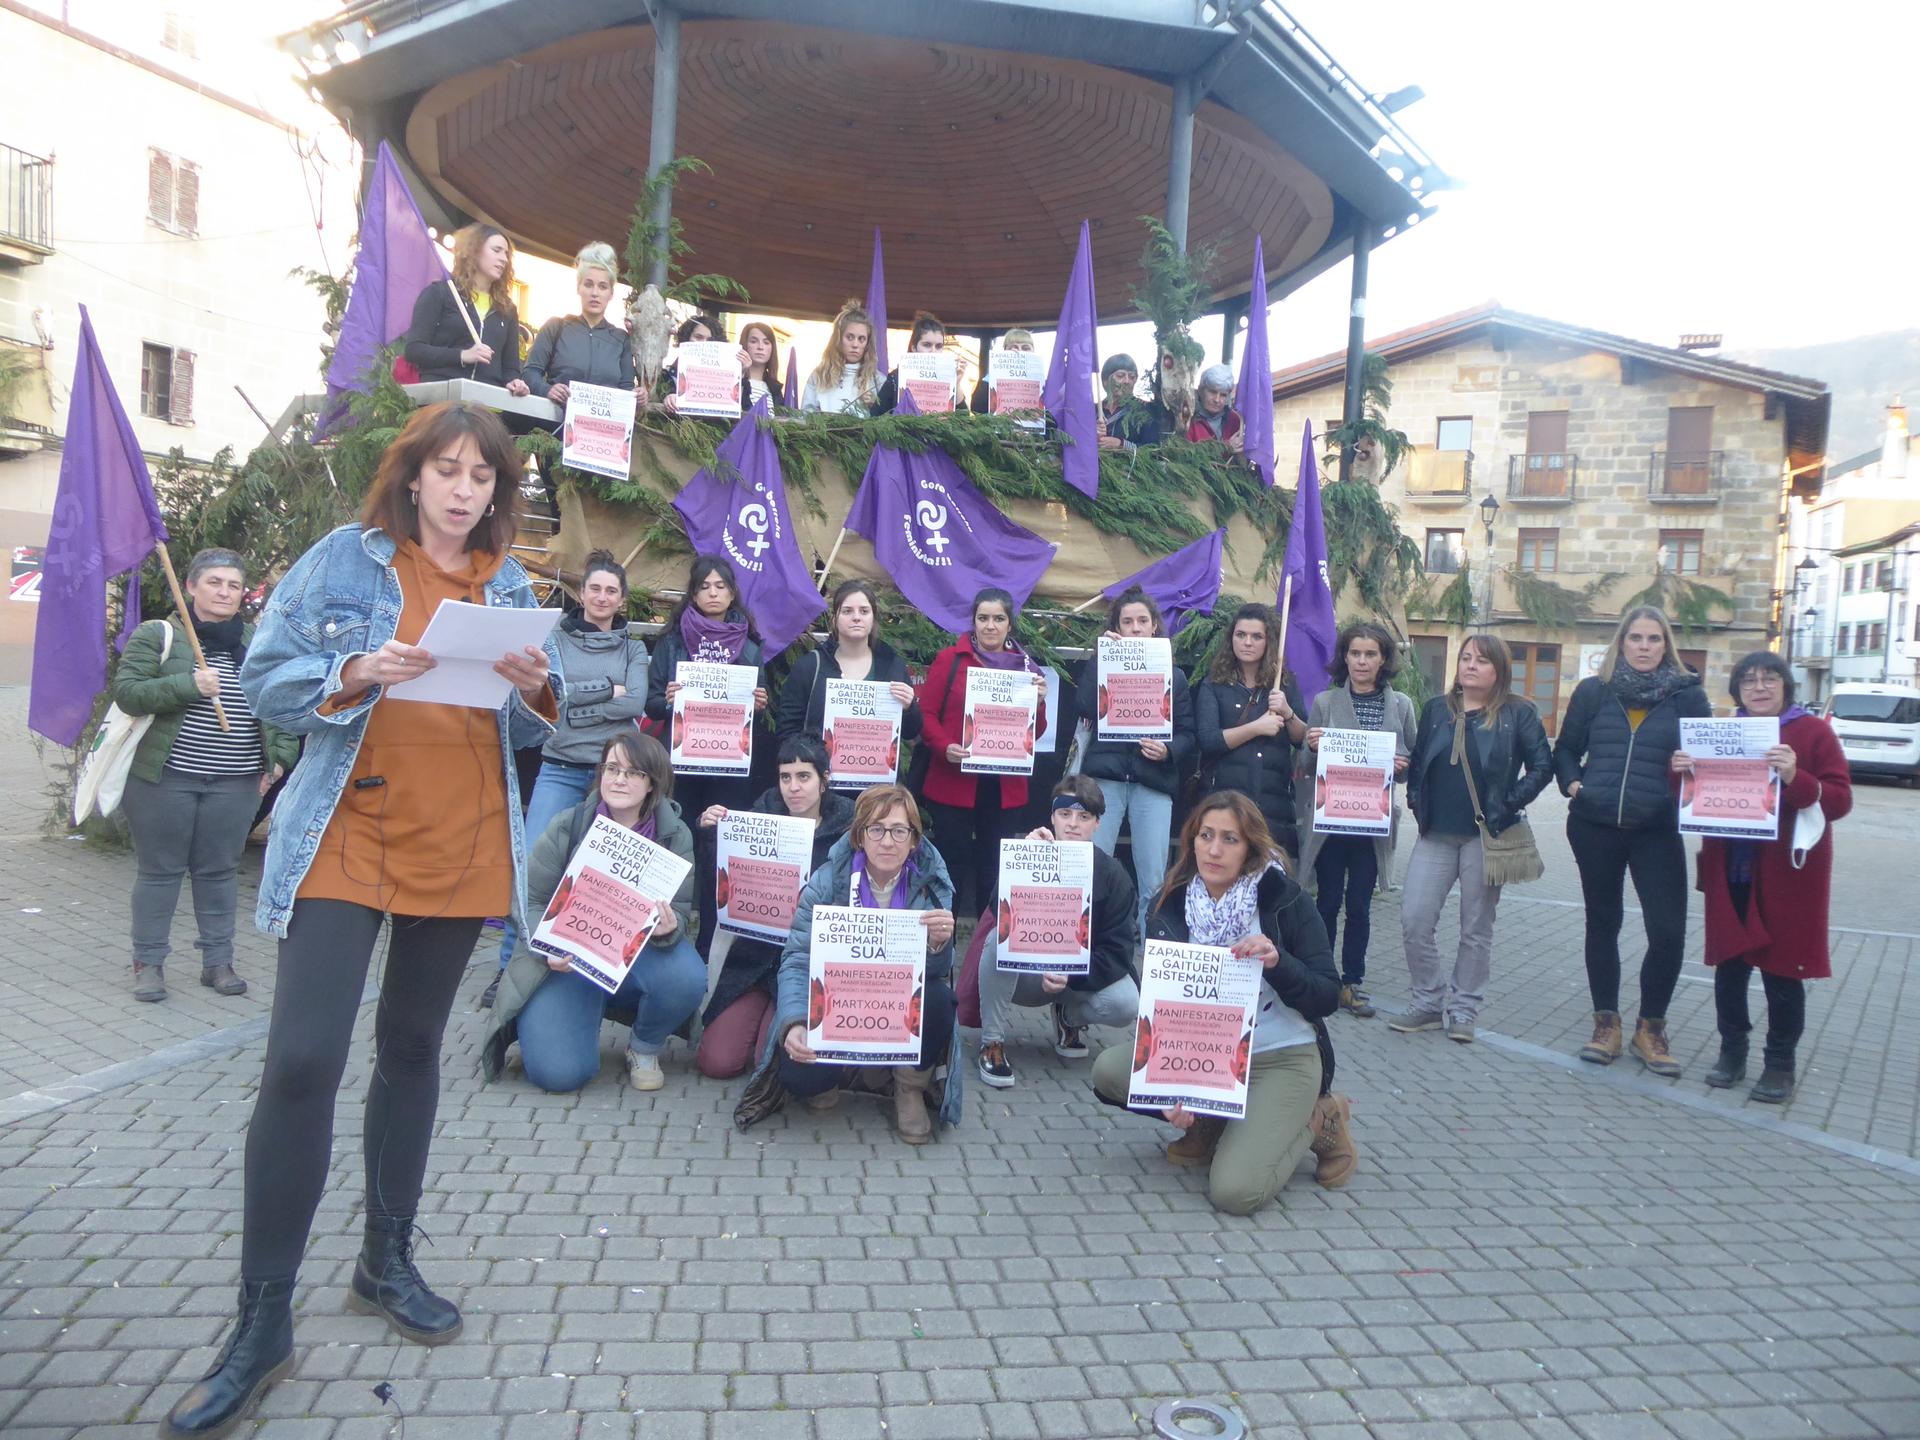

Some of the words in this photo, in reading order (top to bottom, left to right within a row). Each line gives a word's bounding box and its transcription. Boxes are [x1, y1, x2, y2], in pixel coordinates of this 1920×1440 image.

[701, 358, 720, 367] SUA
[692, 391, 722, 400] 20:00
[590, 407, 611, 417] SUA
[581, 444, 612, 455] 20:00
[921, 480, 945, 493] Gora
[679, 665, 728, 674] ZAPALTZEN
[1124, 662, 1147, 670] SUA
[689, 673, 727, 682] GAITUEN
[969, 671, 1012, 680] ZAPALTZEN
[681, 680, 727, 689] SISTEMARI
[829, 683, 875, 691] ZAPALTZEN
[978, 678, 1012, 687] GAITUEN
[971, 685, 1011, 693] SISTEMARI
[704, 690, 728, 700] SUA
[992, 694, 1012, 703] SUA
[831, 698, 874, 706] SISTEMARI
[685, 706, 744, 715] MANIFESTAZIOA
[852, 706, 875, 716] SUA
[975, 709, 1028, 718] MANIFESTAZIOA
[1116, 709, 1150, 718] 20:00
[689, 727, 733, 736] MARTXOAK
[834, 722, 892, 731] MANIFESTAZIOA
[1323, 732, 1367, 740] ZAPALTZEN
[691, 739, 729, 750] 20:00
[980, 739, 1014, 750] 20:00
[1323, 746, 1366, 754] SISTEMARI
[1715, 746, 1745, 756] SUA
[840, 755, 876, 766] 20:00
[1344, 755, 1368, 764] SUA
[1327, 770, 1384, 778] MANIFESTAZIOA
[1333, 800, 1369, 811] 20:00
[1704, 797, 1749, 809] 20:00
[721, 816, 778, 827] ZAPALTZEN
[732, 825, 777, 836] GAITUEN
[595, 820, 654, 855] ZAPALTZEN
[723, 833, 776, 845] SISTEMARI
[603, 835, 650, 864] GAITUEN
[749, 845, 778, 858] SUA
[1003, 844, 1059, 853] ZAPALTZEN
[589, 840, 644, 872] SISTEMARI
[1014, 853, 1058, 862] GAITUEN
[728, 862, 800, 878] MANIFESTAZIOA
[1006, 862, 1058, 871] SISTEMARI
[610, 862, 640, 886] SUA
[1032, 872, 1061, 883] SUA
[579, 872, 652, 916] MANIFESTAZIOA
[735, 888, 784, 902] MARTXOAK
[738, 900, 780, 917] 20:00
[572, 901, 625, 934] MARTXOAK
[816, 912, 884, 924] ZAPALTZEN
[1017, 918, 1068, 927] MARTXOAK
[566, 915, 612, 946] 20:00
[830, 923, 883, 934] GAITUEN
[819, 933, 882, 945] SISTEMARI
[1020, 931, 1064, 943] 20:00
[851, 946, 886, 959] SUA
[1148, 945, 1220, 962] ZAPALTZEN
[1162, 960, 1219, 974] GAITUEN
[825, 970, 913, 980] MANIFESTAZIOA
[1151, 969, 1216, 984] SISTEMARI
[1183, 984, 1219, 999] SUA
[833, 1000, 895, 1010] MARTXOAK
[1154, 1008, 1243, 1023] MANIFESTAZIOA
[836, 1015, 889, 1030] 20:00
[1159, 1040, 1222, 1053] MARTXOAK
[1160, 1056, 1214, 1073] 20:00
